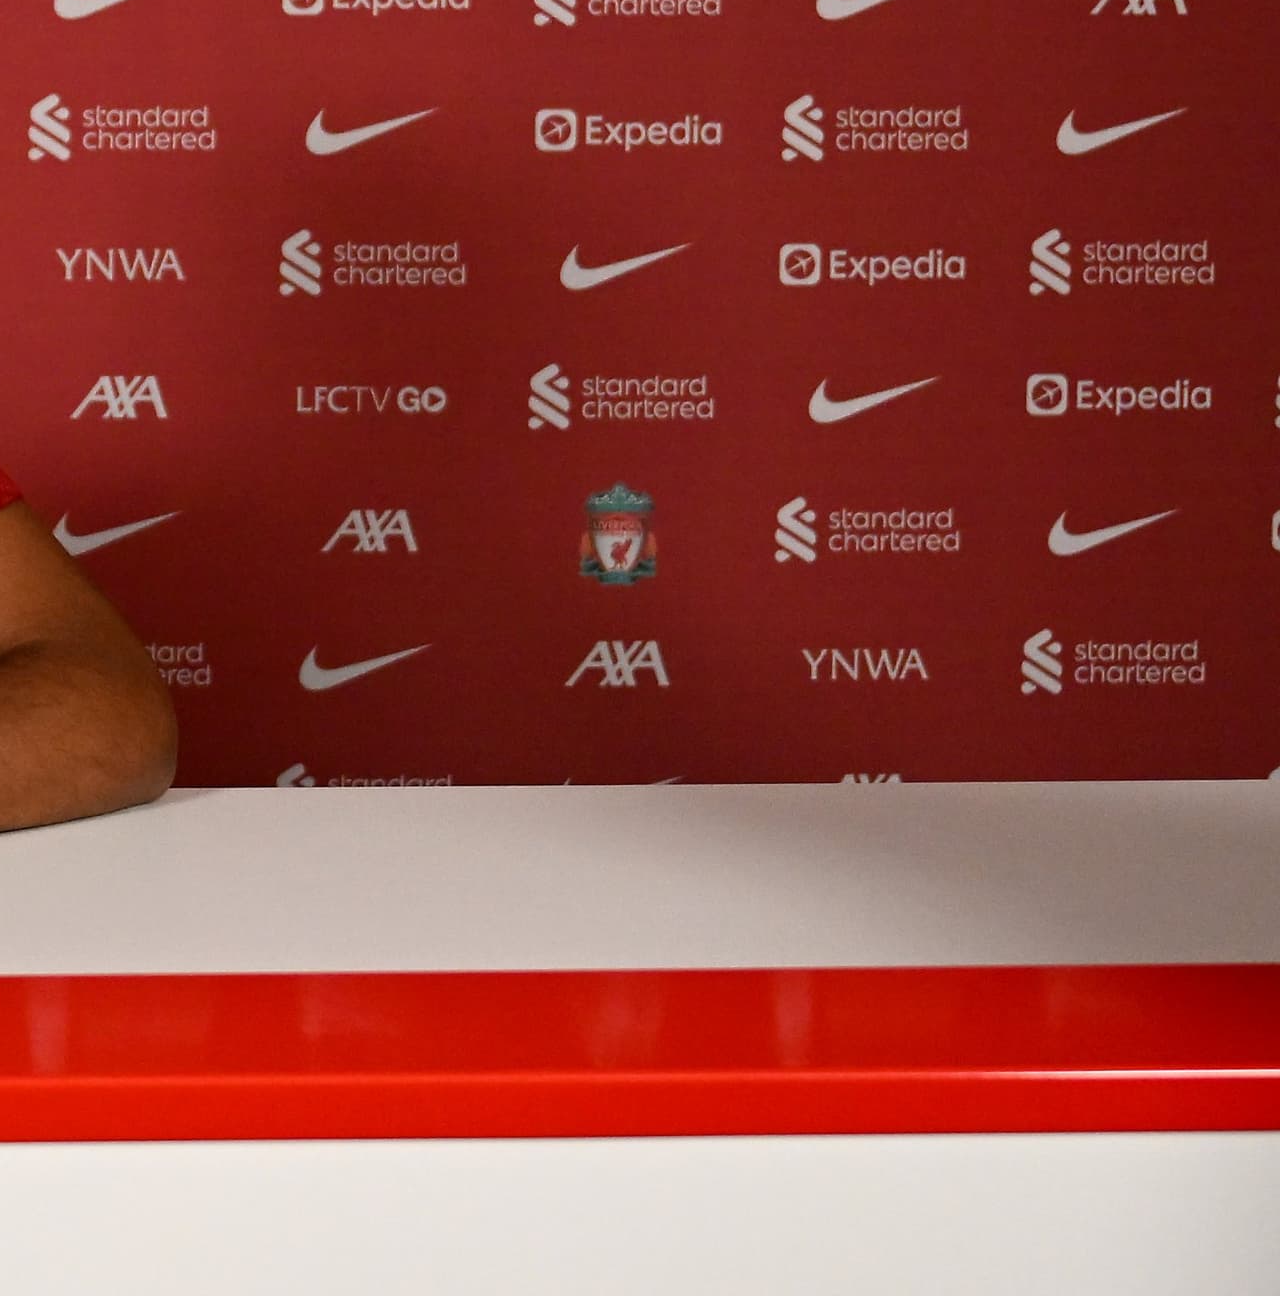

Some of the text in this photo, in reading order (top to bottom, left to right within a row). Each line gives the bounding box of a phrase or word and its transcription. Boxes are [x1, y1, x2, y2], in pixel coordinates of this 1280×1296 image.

[83, 106, 208, 129] standard
[585, 115, 722, 152] Expedia
[83, 129, 216, 150] chartered
[56, 248, 185, 281] YNWA
[334, 242, 458, 262] standard
[830, 249, 966, 286] Expedia
[334, 265, 466, 285] chartered
[70, 375, 168, 419] AXA
[1076, 379, 1211, 415] Expedia
[322, 510, 418, 552] AXA
[567, 641, 669, 686] AXA
[802, 649, 928, 680] YNWA
[1075, 641, 1198, 661] standard
[1075, 663, 1205, 683] chartered
